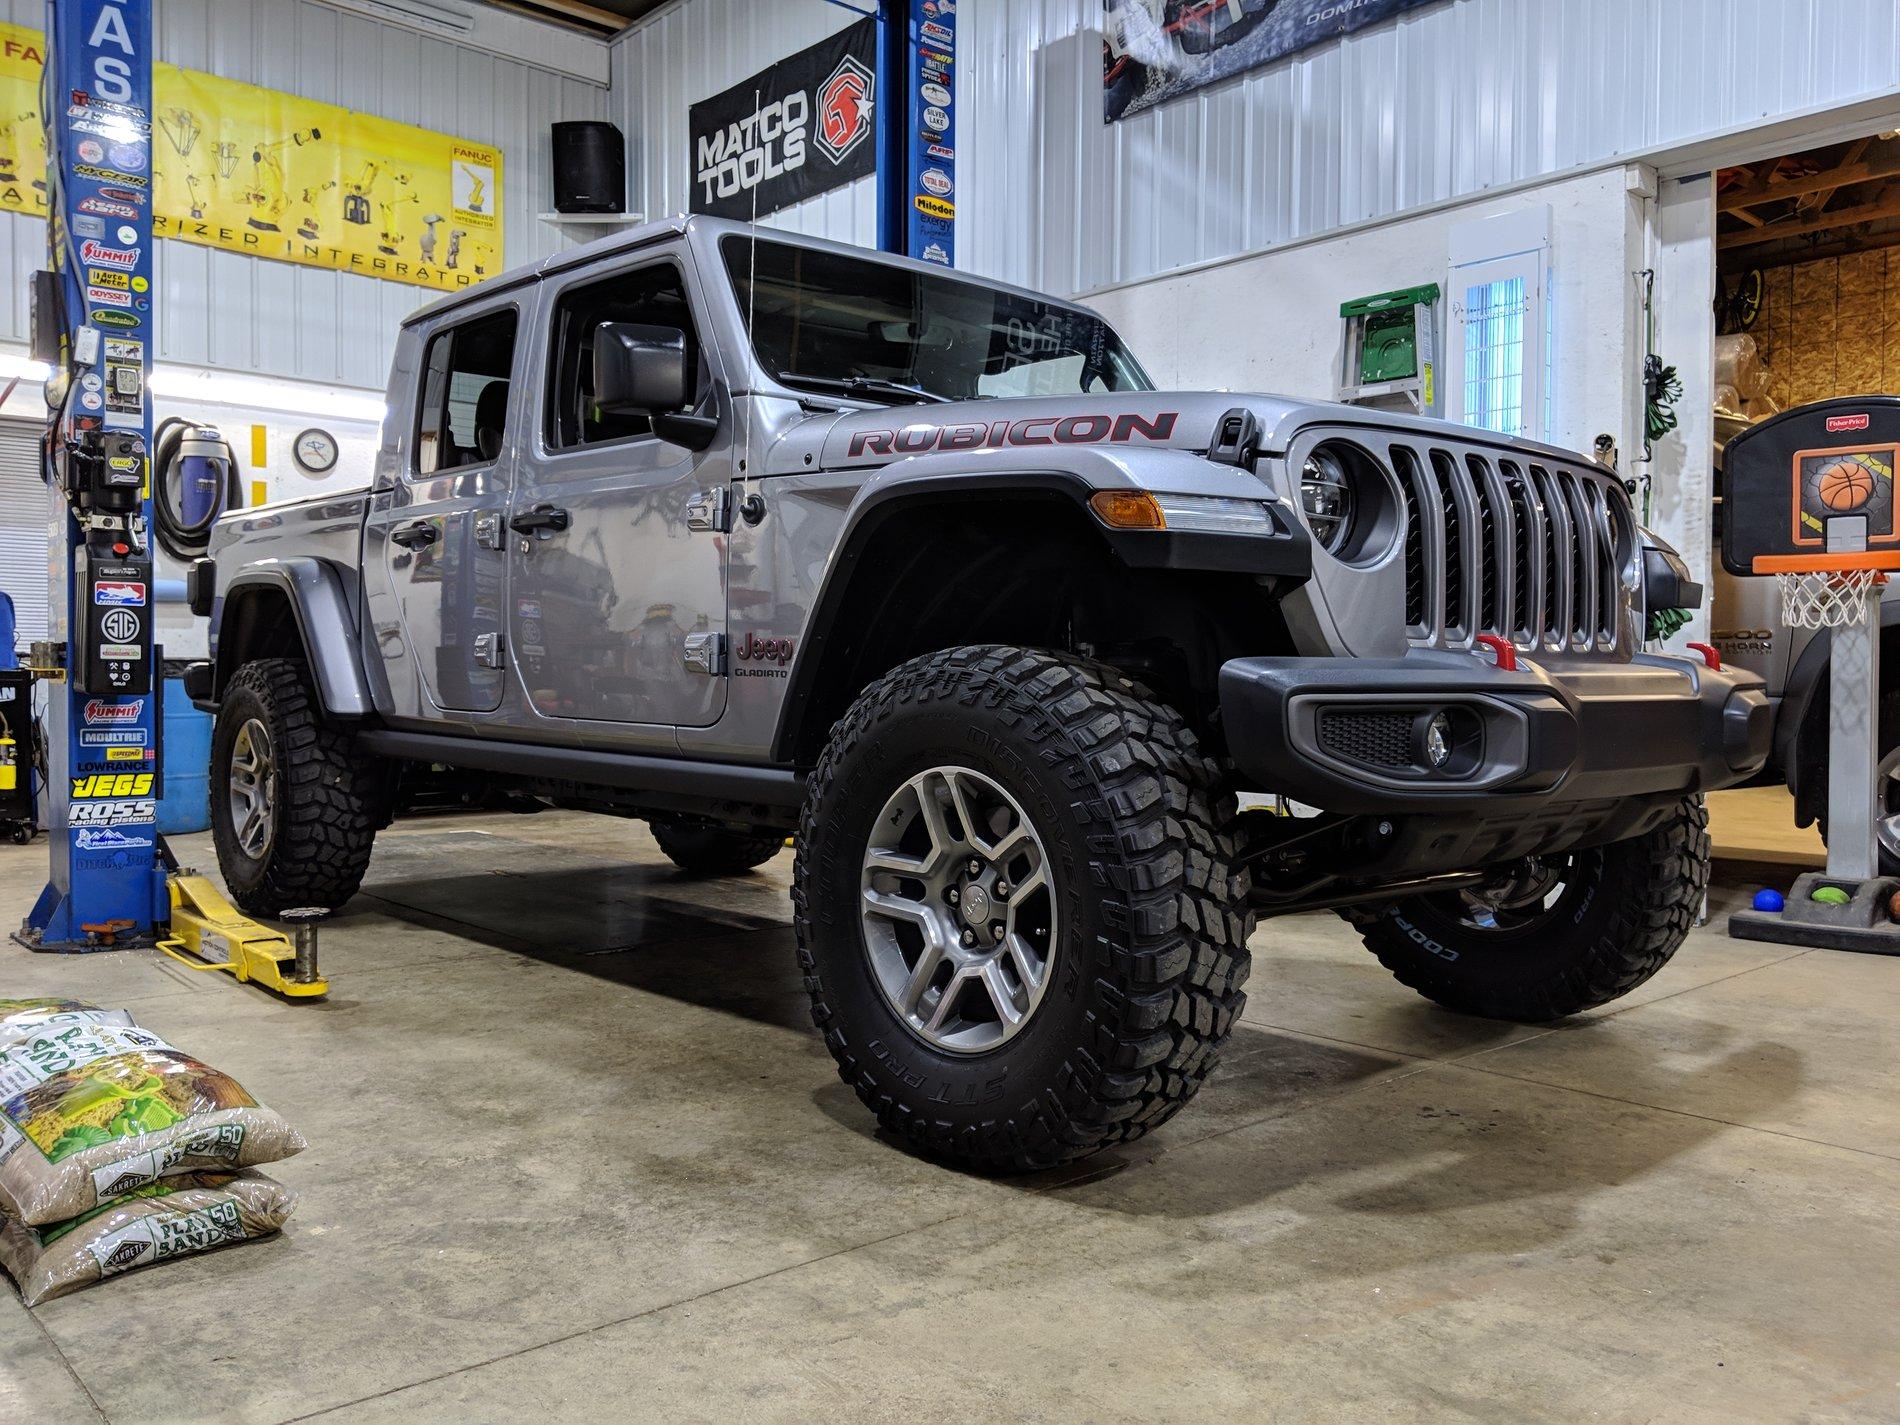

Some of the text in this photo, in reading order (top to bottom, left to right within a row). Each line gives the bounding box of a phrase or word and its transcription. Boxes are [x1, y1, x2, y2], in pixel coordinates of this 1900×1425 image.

[1305, 0, 1368, 26] DOMI
[927, 109, 945, 119] SILVER
[929, 116, 944, 126] LAKE
[697, 89, 809, 171] MATCO
[453, 147, 493, 163] FANUC
[697, 127, 807, 204] TOOLS
[454, 209, 494, 221] AUTHORIZED
[917, 198, 955, 216] Milodon
[454, 216, 494, 228] INTEGRATOR
[83, 242, 135, 263] SUMMIT
[99, 278, 127, 287] Meter
[101, 272, 123, 281] Auto
[89, 289, 130, 301] ODYSSEY
[1828, 417, 1866, 427] Fisher-Price
[847, 412, 1179, 457] RUBICON
[106, 612, 135, 639] SIG
[736, 632, 793, 666] Jeep
[86, 701, 139, 720] SUMMIT
[85, 732, 144, 743] MOULTRIE
[77, 761, 150, 772] LOWRANCE
[72, 773, 155, 798] JEGS
[69, 801, 156, 820] ROSS
[69, 815, 155, 827] racing pistons
[868, 1039, 928, 1088] PRO
[927, 1072, 1007, 1105] STT
[220, 1125, 244, 1144] 50
[107, 1176, 144, 1195] SAKRETE
[211, 1202, 237, 1223] 50
[160, 1217, 208, 1240] PLAY
[158, 1228, 223, 1256] SAND
